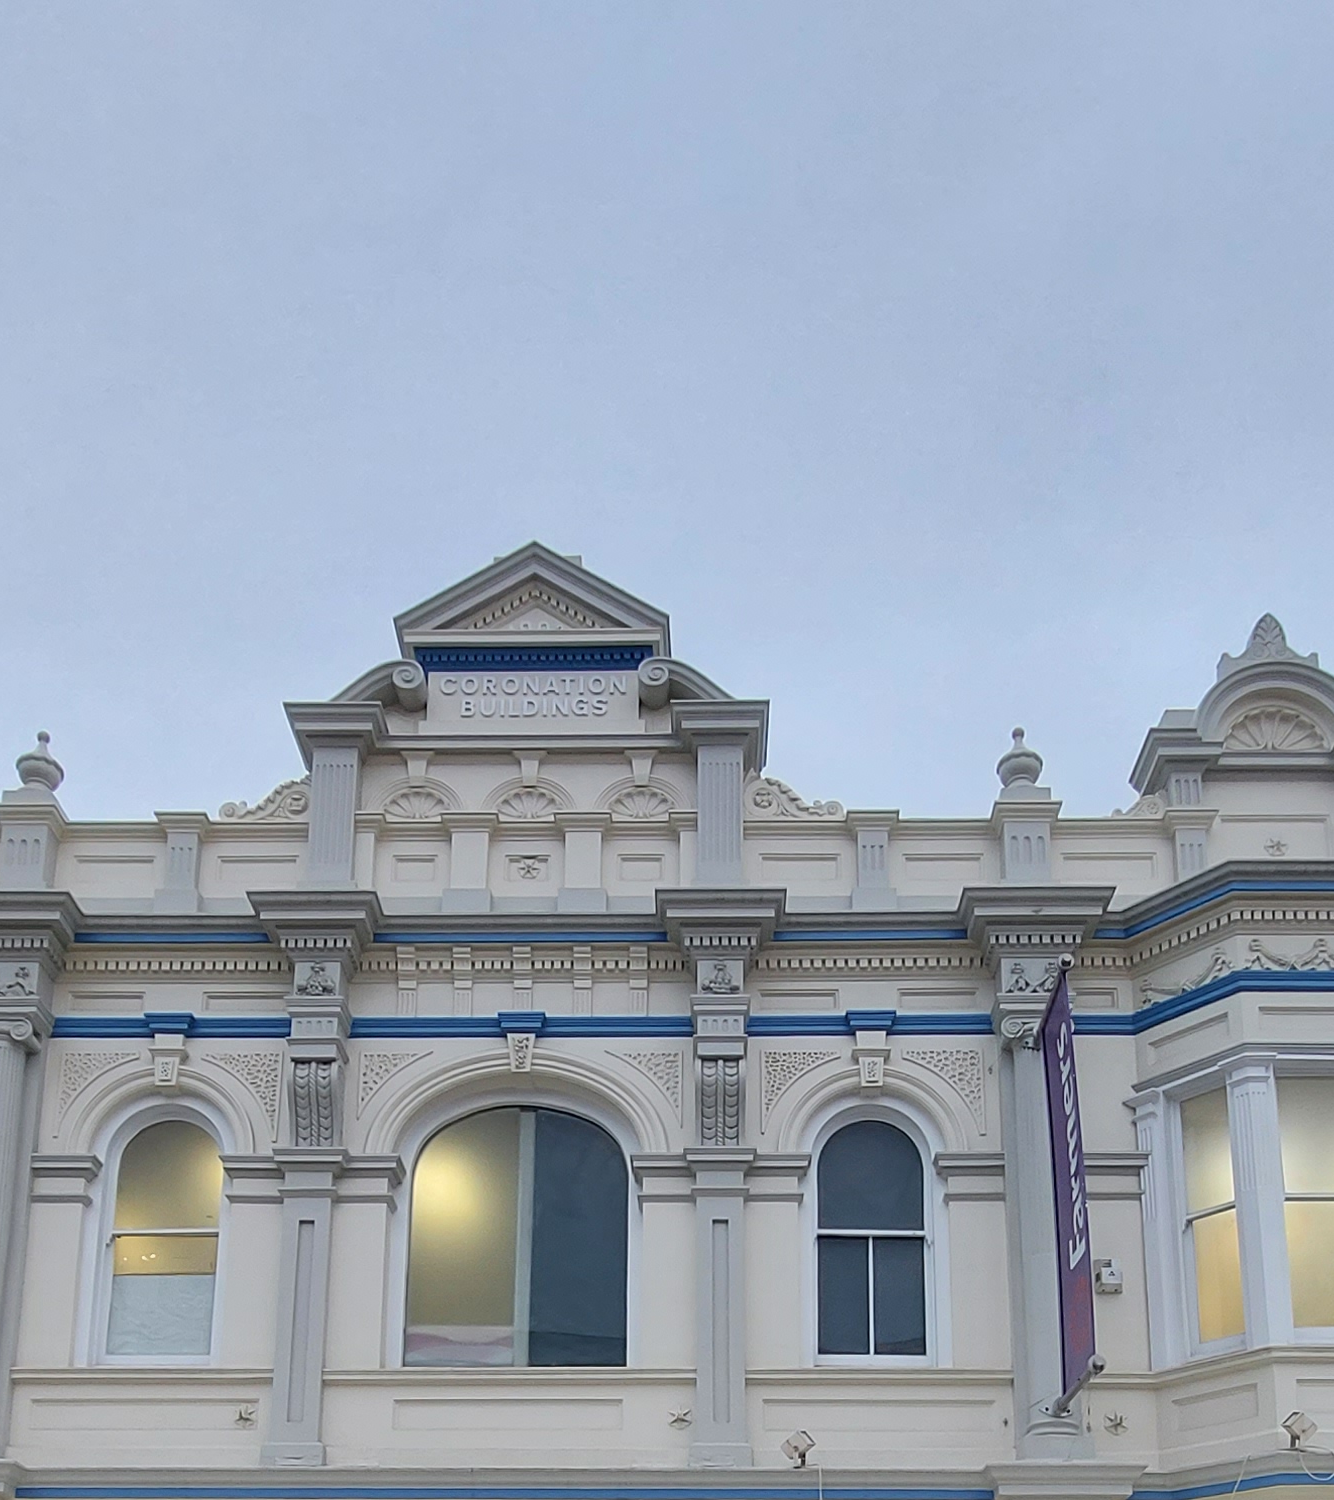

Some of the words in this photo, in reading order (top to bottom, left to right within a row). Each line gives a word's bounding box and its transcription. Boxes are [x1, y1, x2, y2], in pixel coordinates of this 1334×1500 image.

[439, 675, 628, 696] CORONATION
[460, 698, 609, 718] BUILDINGS
[1056, 1021, 1086, 1270] Farmers
